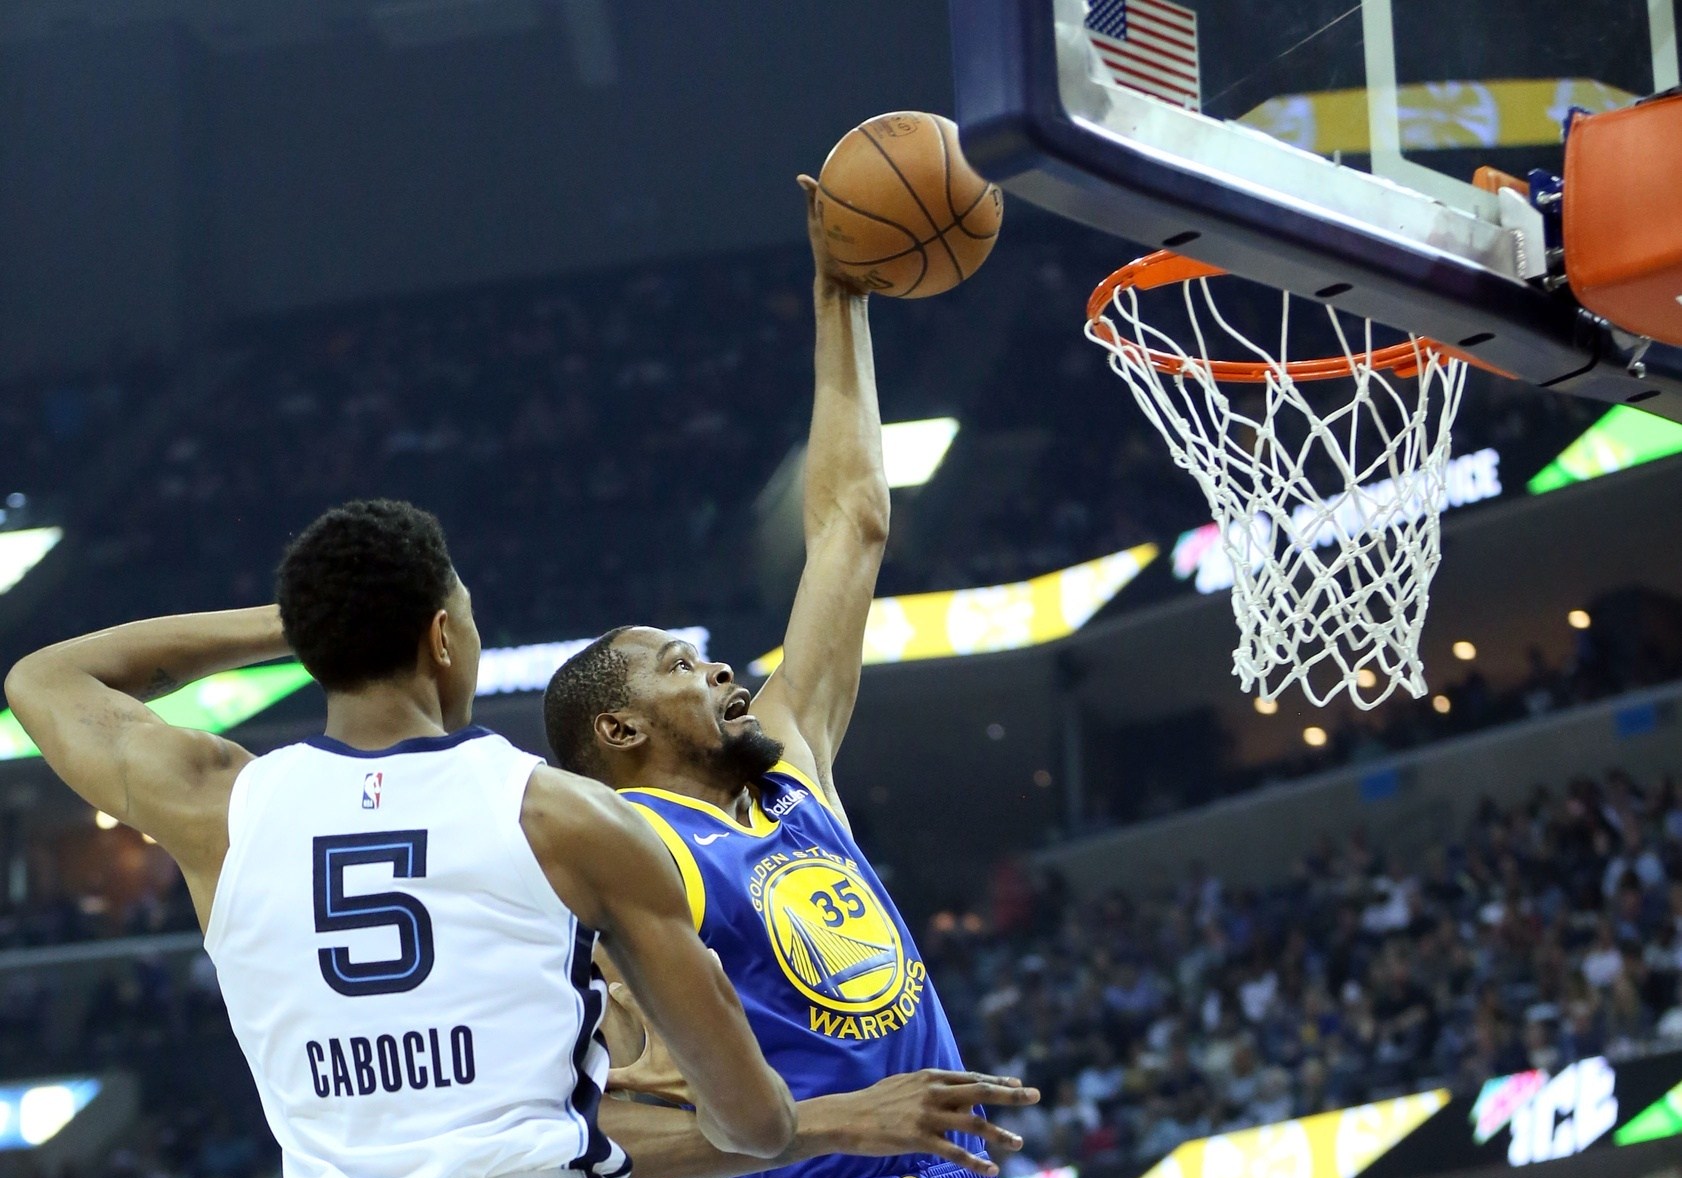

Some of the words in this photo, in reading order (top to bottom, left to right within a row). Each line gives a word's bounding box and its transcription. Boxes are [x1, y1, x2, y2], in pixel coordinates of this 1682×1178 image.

[311, 828, 436, 998] 5
[749, 852, 789, 913] GOLDEN
[792, 845, 858, 873] STATE
[809, 877, 867, 929] 35
[809, 958, 927, 1041] WARRIORS
[306, 1024, 476, 1098] CABOCLO
